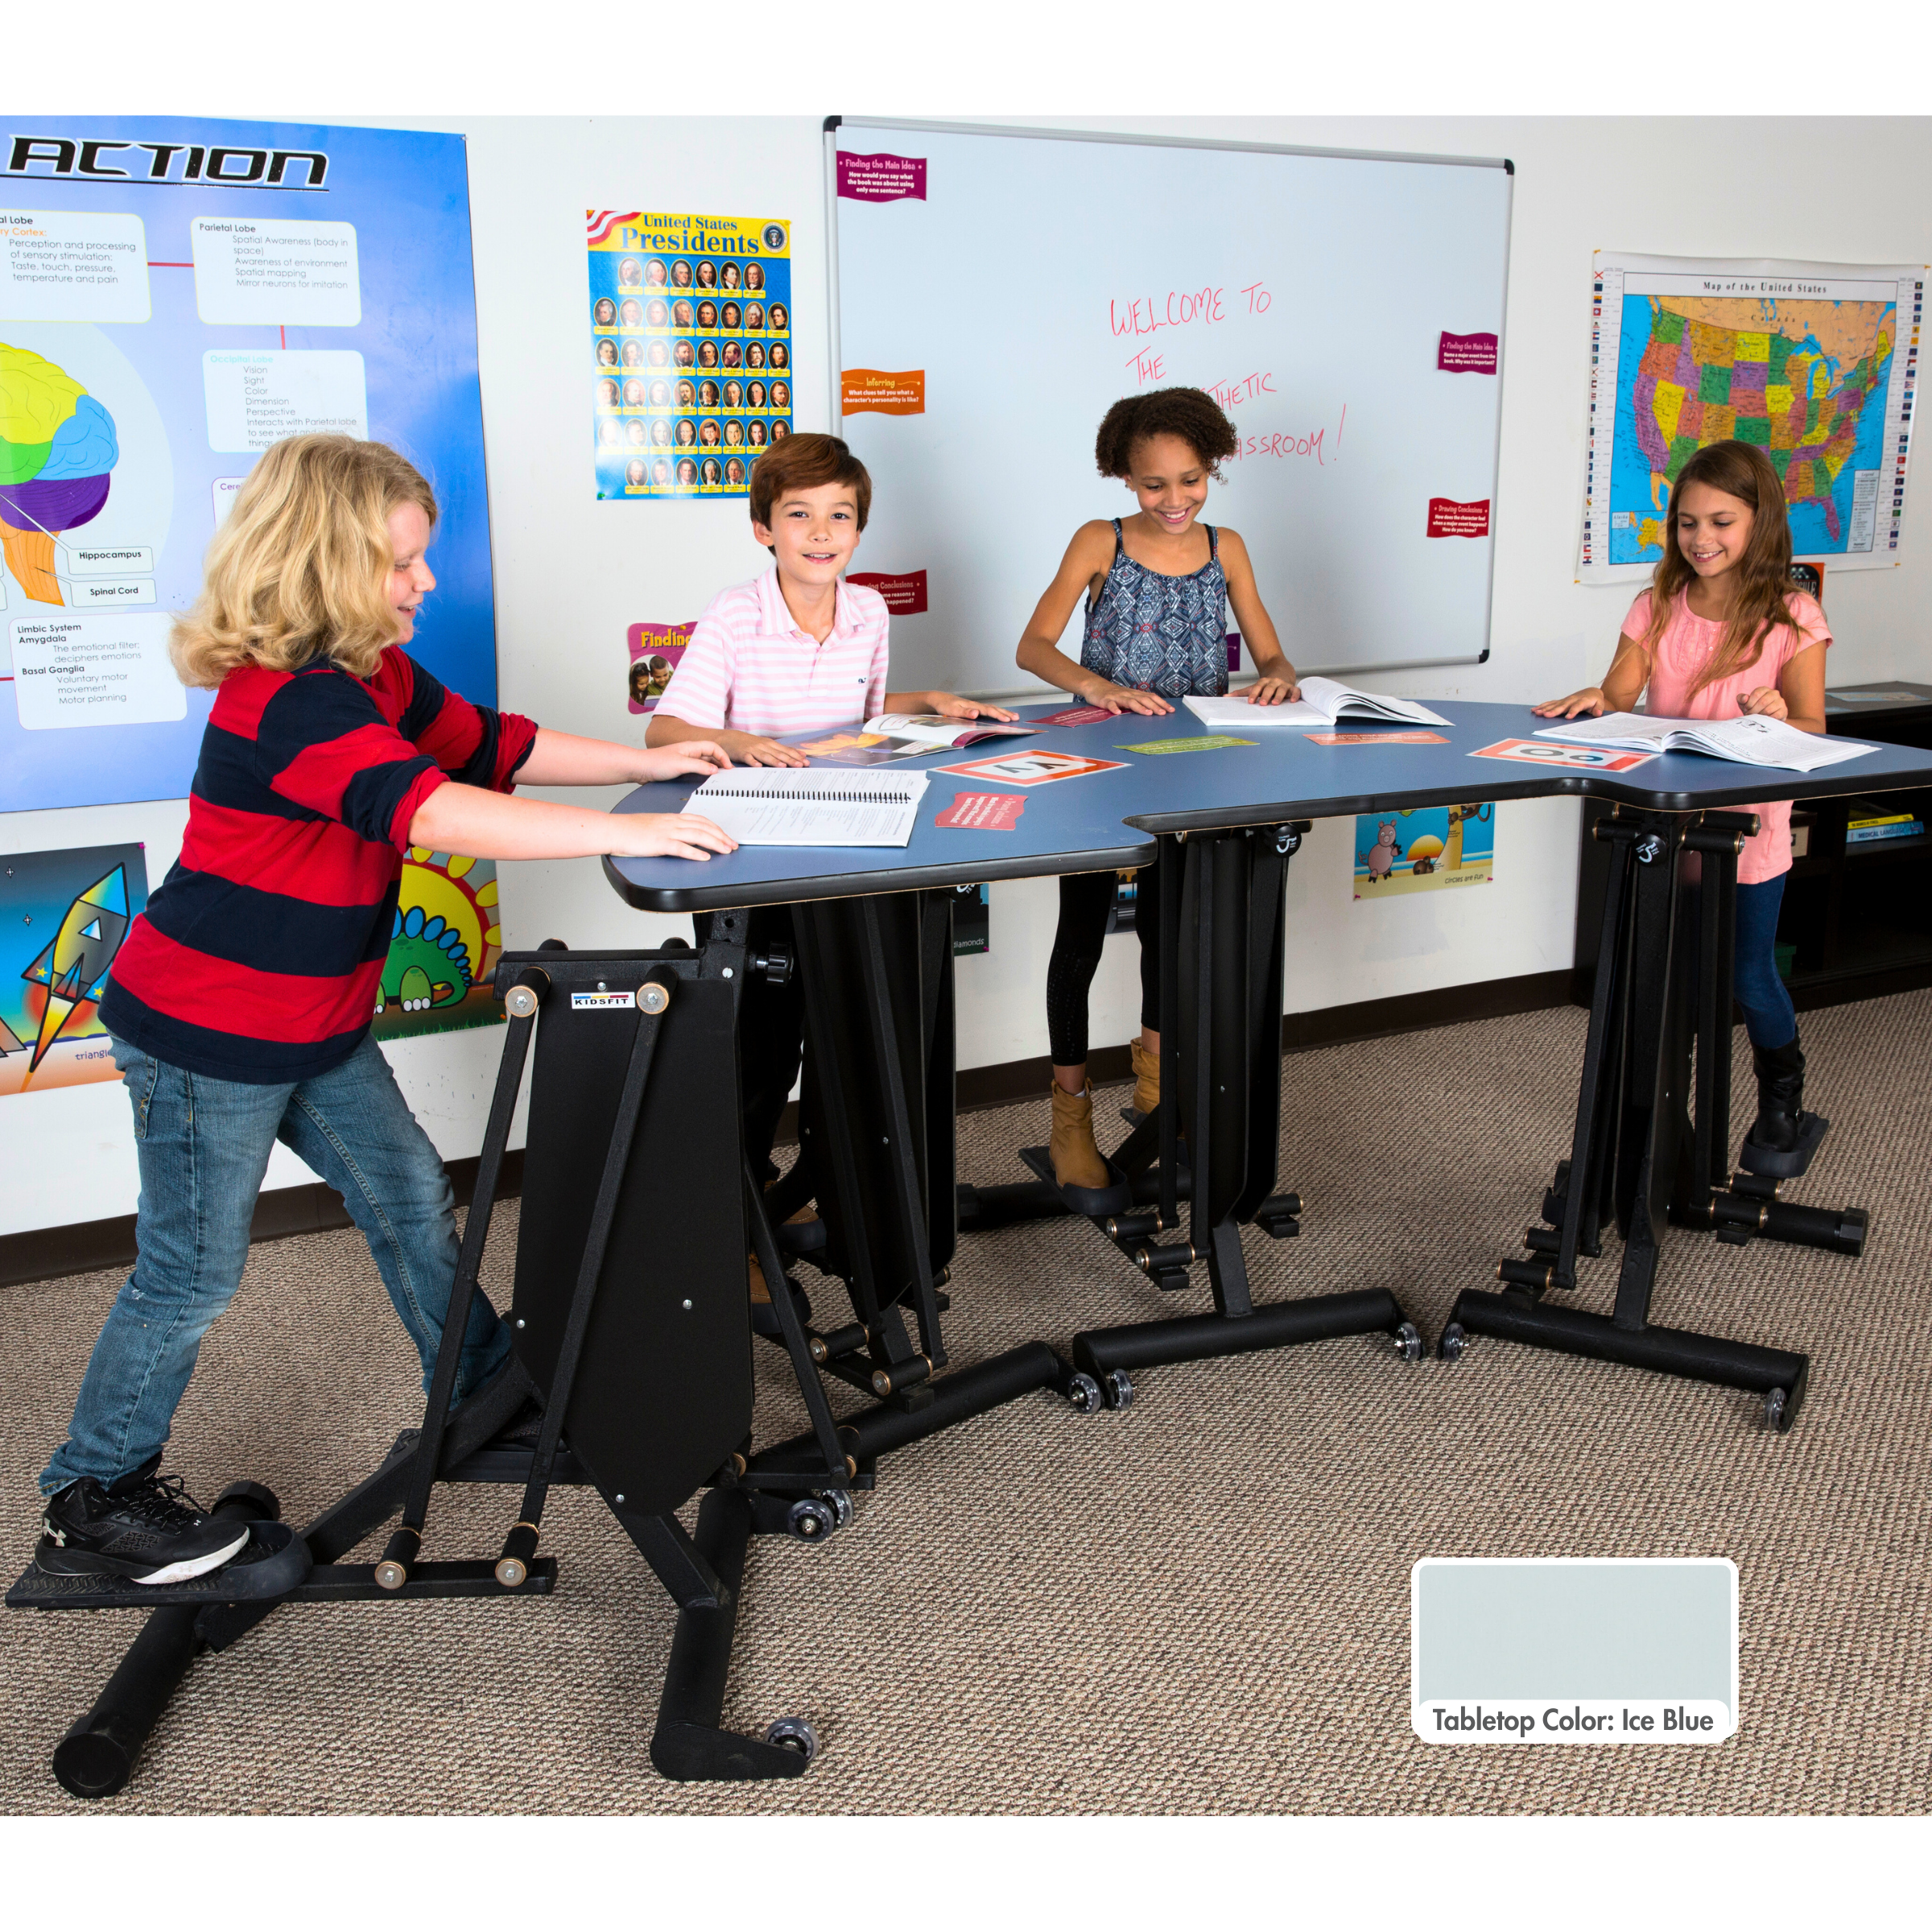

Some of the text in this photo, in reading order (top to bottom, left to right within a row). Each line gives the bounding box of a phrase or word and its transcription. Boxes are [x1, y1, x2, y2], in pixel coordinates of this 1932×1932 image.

[9, 135, 329, 188] ACTION
[845, 158, 915, 171] Finding the Main Idea
[10, 216, 33, 225] Lobe
[644, 214, 737, 231] United States
[12, 227, 47, 237] Cortex:
[200, 224, 256, 233] Parietal Lobe
[10, 239, 61, 250] Perception
[87, 242, 136, 252] processing
[233, 235, 347, 247] Spatial Awareness (body in
[620, 228, 760, 254] Presidents
[10, 250, 112, 261] of sensory stimulation:
[234, 247, 263, 256] space)
[11, 262, 115, 273] Taste, touch, pressure,
[235, 268, 306, 279] Spatial mapping
[13, 274, 72, 283] temperature
[97, 275, 118, 284] pain
[1703, 282, 1721, 291] Map
[1761, 283, 1793, 292] United
[1798, 283, 1827, 293] States
[1111, 282, 1271, 336] WELCOME TO
[1447, 341, 1463, 352] Finding
[1484, 343, 1493, 351] Idea
[210, 355, 250, 363] Occipital
[1125, 345, 1166, 386] THE
[244, 377, 264, 385] Sight
[866, 378, 895, 389] Inferring
[246, 408, 295, 416] Perspective
[249, 440, 273, 448] things
[1439, 505, 1482, 514] Drawing Conclusions
[79, 551, 141, 560] Hippocampus
[881, 580, 914, 589] Conclusions
[90, 588, 115, 597] Spinal
[18, 624, 81, 634] Limbic System
[19, 635, 67, 644] Amygdala
[72, 642, 117, 652] emotional
[55, 652, 141, 663] deciphers emotions
[49, 666, 85, 674] Ganglia
[57, 675, 99, 684] Voluntary
[58, 685, 106, 694] movement
[88, 695, 126, 704] planning
[1858, 831, 1879, 839] MEDICAL
[1880, 828, 1905, 836] LANGUAGE
[1445, 875, 1463, 884] circles
